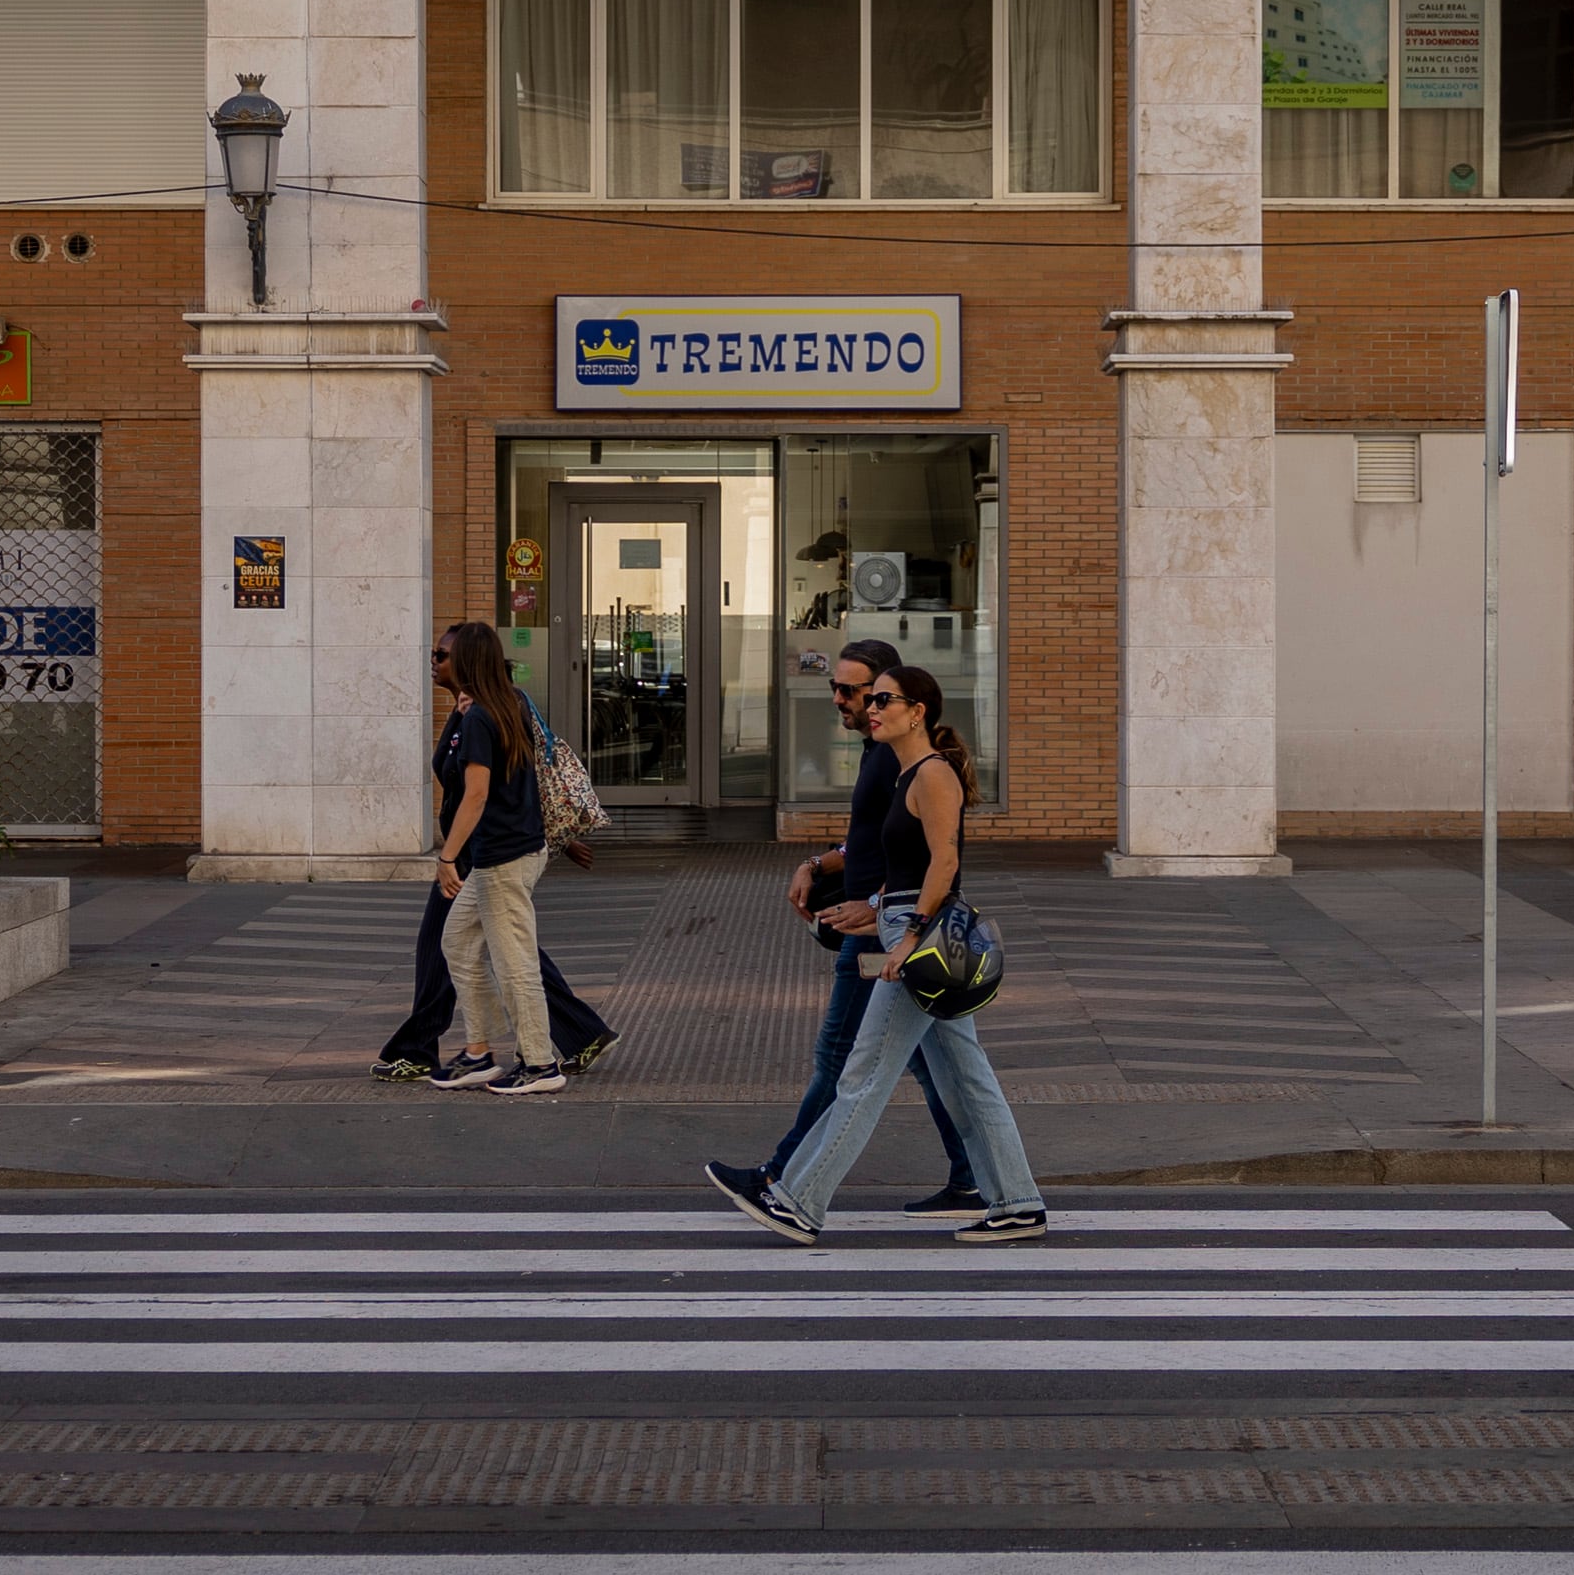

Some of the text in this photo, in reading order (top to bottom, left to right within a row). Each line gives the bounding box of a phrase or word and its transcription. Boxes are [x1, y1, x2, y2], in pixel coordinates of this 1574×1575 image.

[1418, 3, 1466, 11] CALLE REAL
[1405, 38, 1410, 46] 2
[1412, 38, 1418, 46] Y
[1426, 38, 1480, 46] DORMITORIOS
[1406, 54, 1478, 63] FINANCIACIÓN
[1407, 66, 1478, 74] HASTA EL 100%
[1297, 87, 1309, 95] de
[1311, 87, 1316, 95] 2
[1326, 87, 1332, 95] 3
[1333, 87, 1383, 95] Dormitorios
[1316, 96, 1348, 105] Garaje
[650, 331, 925, 374] TREMENDO
[577, 364, 638, 375] TREMENDO
[240, 565, 280, 576] GRACIAS
[509, 567, 540, 575] HALAL
[239, 575, 281, 587] CEUTA
[21, 661, 75, 692] 70
